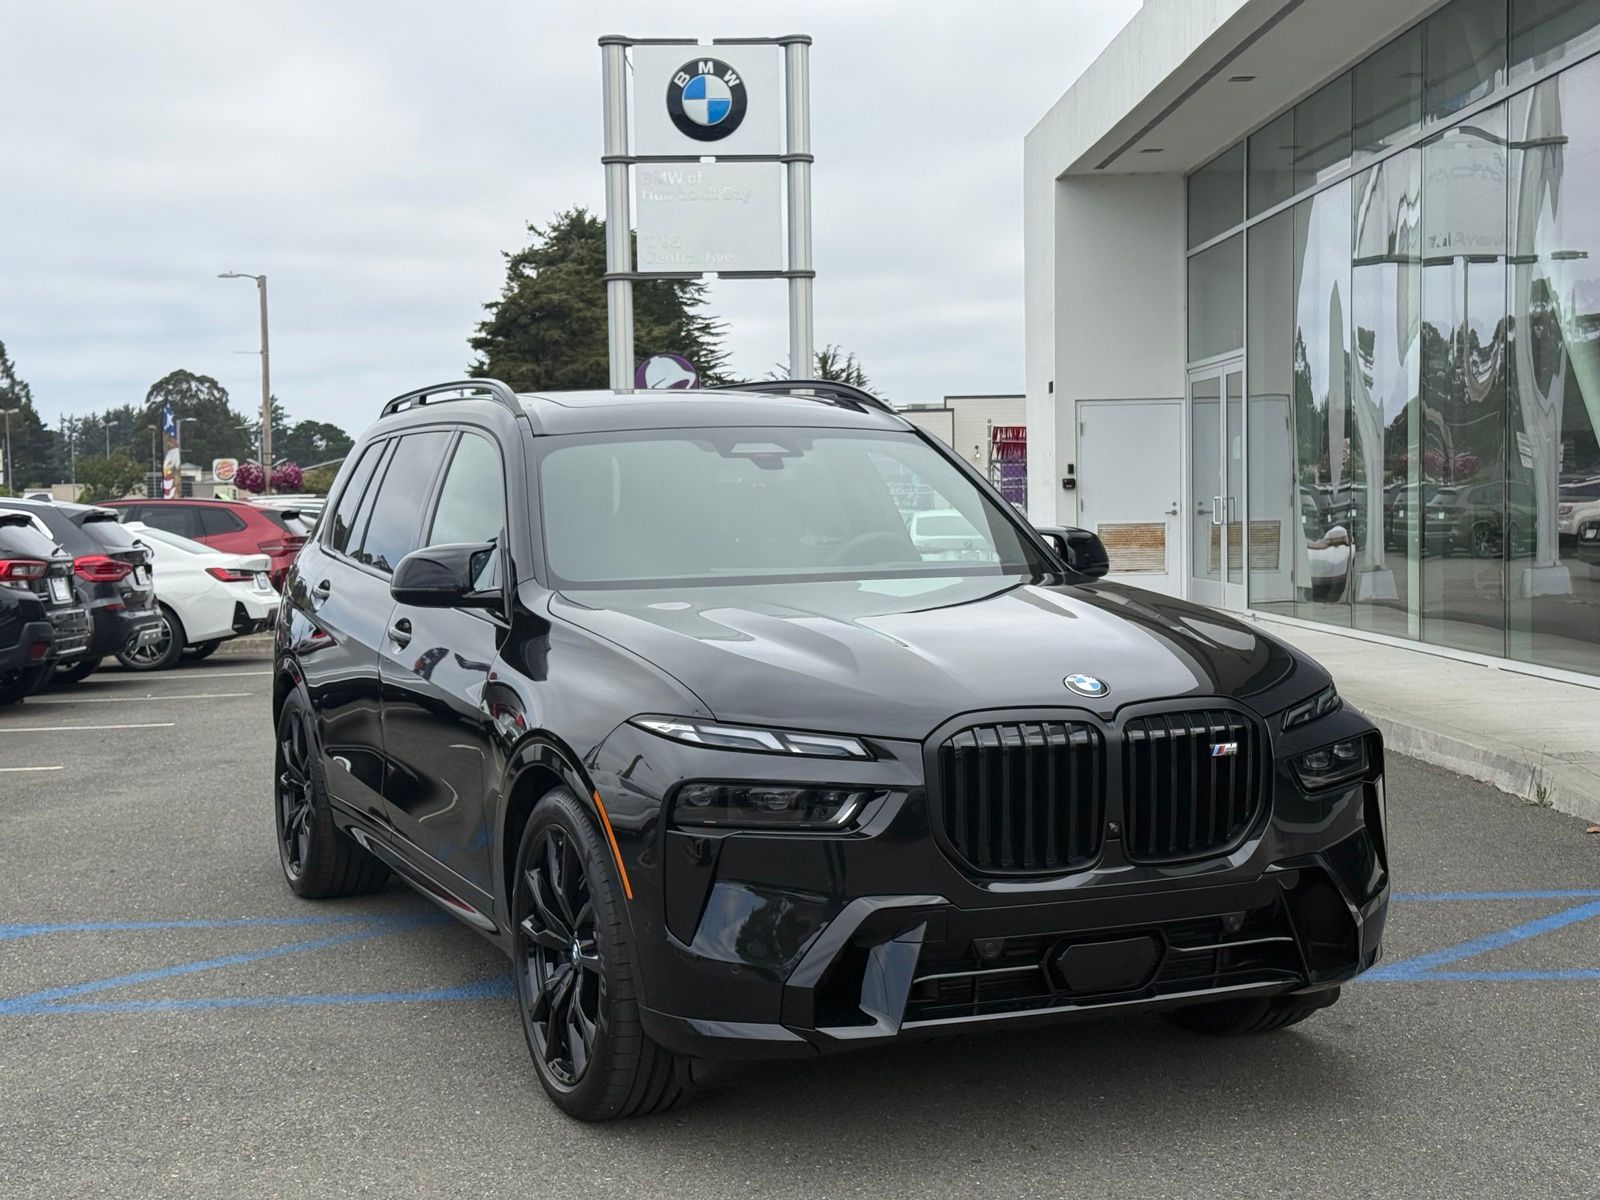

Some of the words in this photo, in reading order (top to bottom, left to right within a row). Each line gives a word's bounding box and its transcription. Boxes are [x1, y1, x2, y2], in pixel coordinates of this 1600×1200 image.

[673, 60, 740, 89] BMW
[641, 170, 683, 185] BMW
[687, 170, 705, 185] of
[643, 250, 700, 265] Centr
[705, 250, 736, 265] Ave
